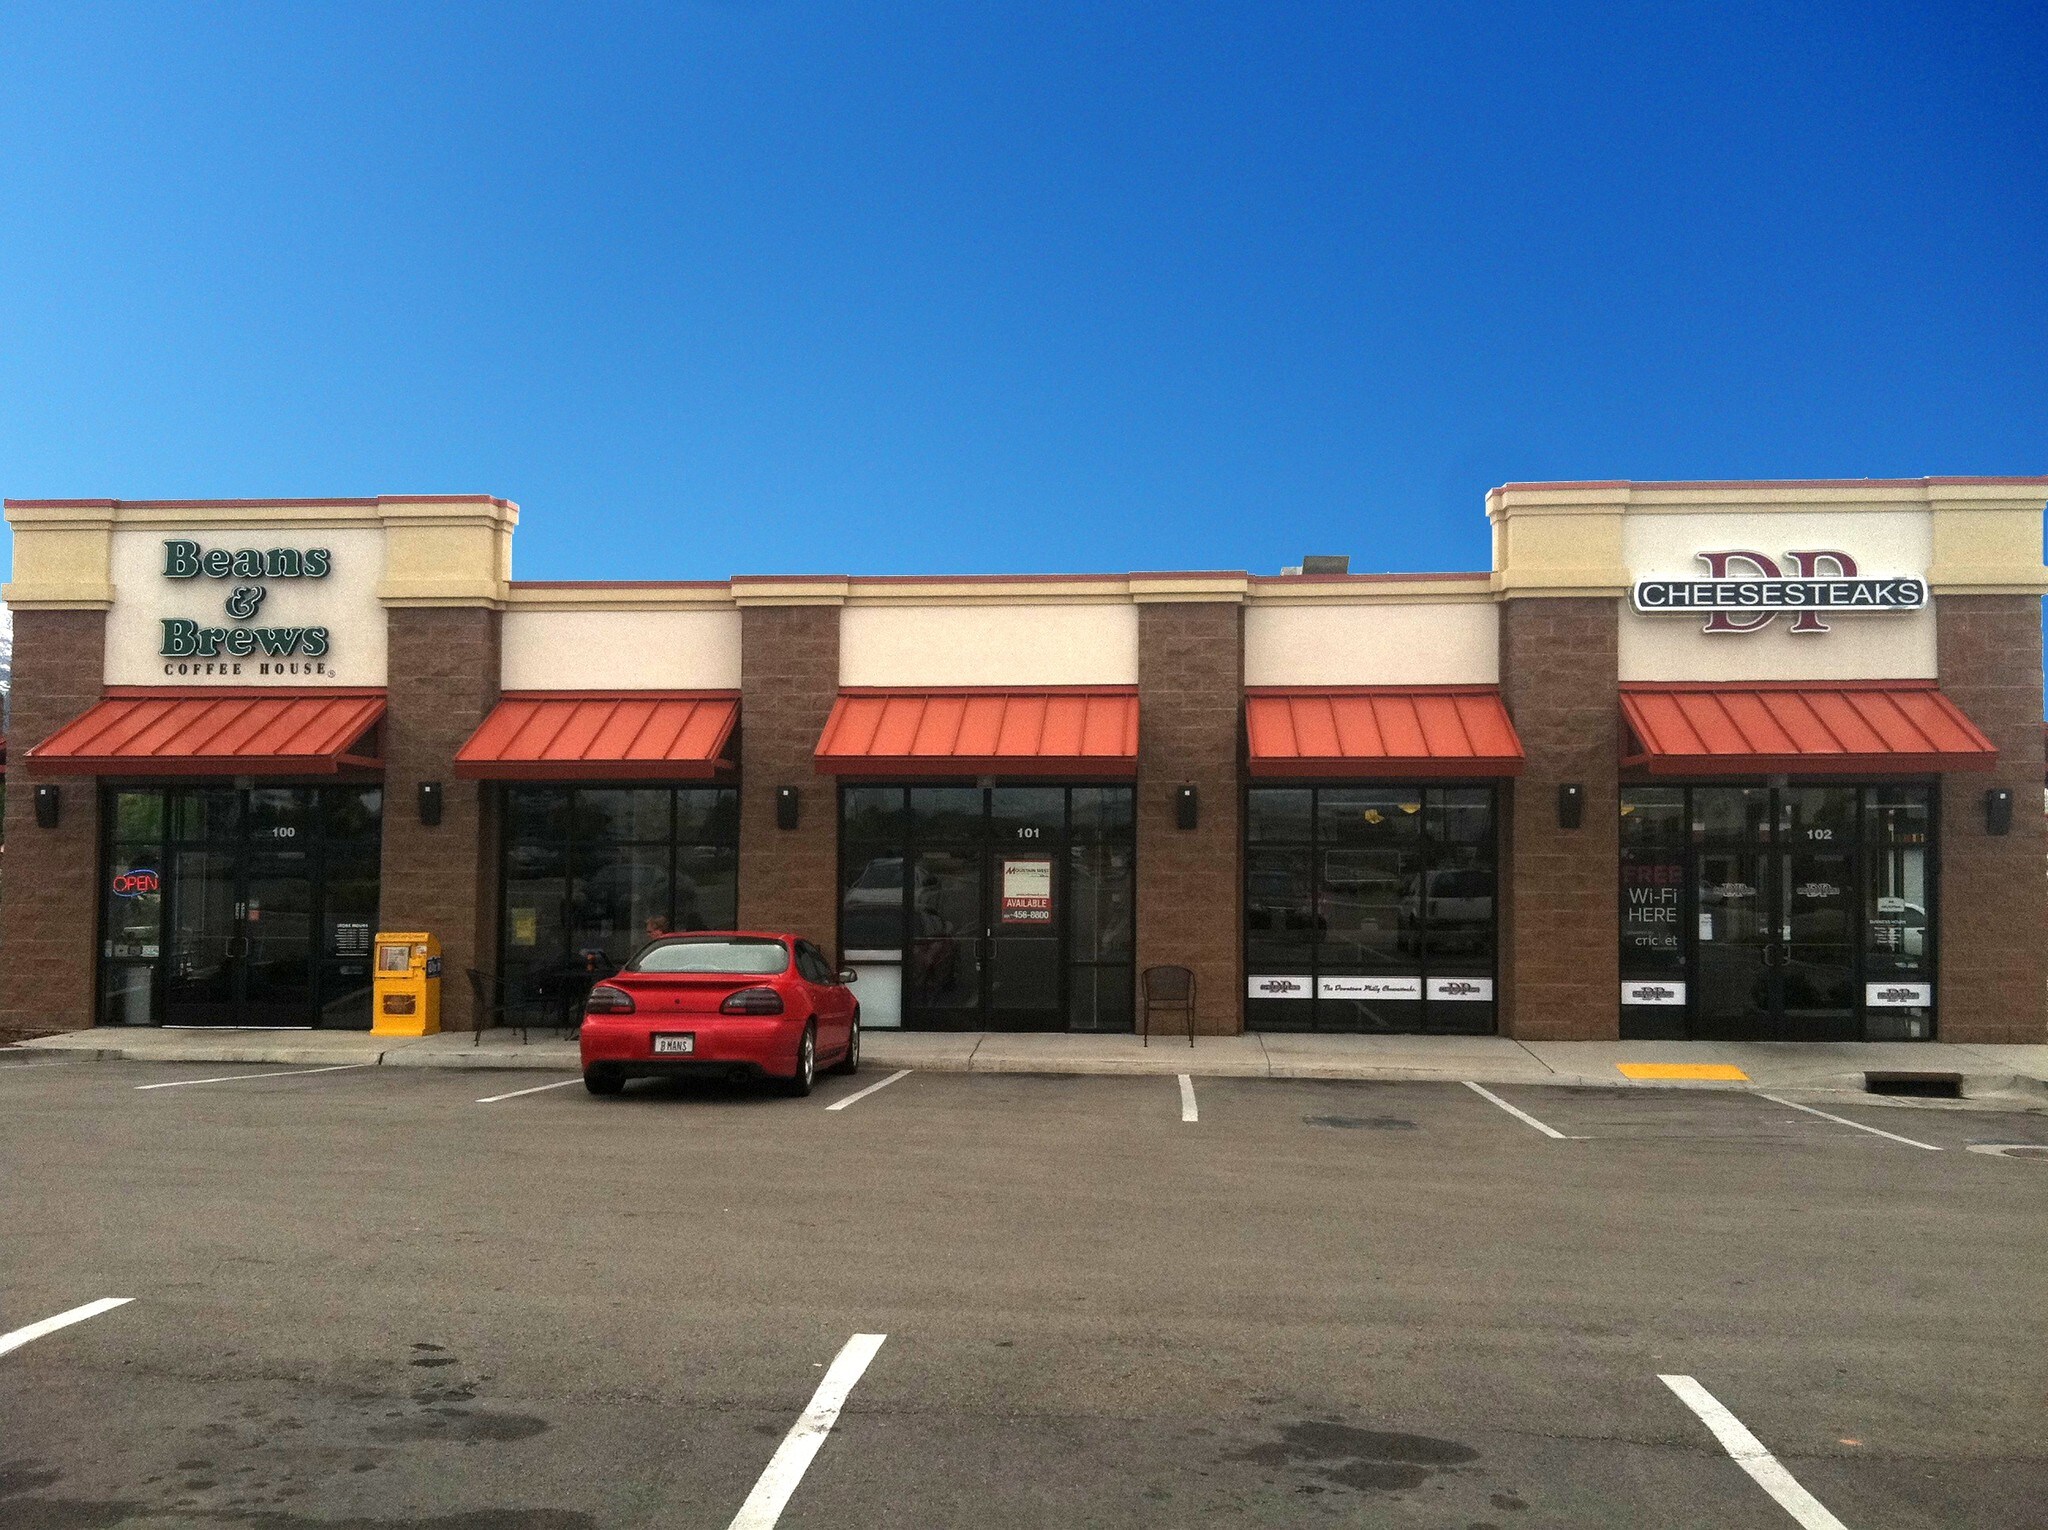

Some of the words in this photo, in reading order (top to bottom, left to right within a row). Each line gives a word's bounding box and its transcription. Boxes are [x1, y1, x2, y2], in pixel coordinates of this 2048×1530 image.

[161, 539, 331, 578] Beans
[225, 585, 266, 619] &
[1642, 582, 1919, 607] CHEESESTEAKS
[158, 618, 330, 658] Brews
[164, 663, 242, 676] COFFEE
[259, 662, 326, 676] HOUSE
[272, 827, 295, 838] 100
[1017, 827, 1040, 838] 101
[1807, 829, 1833, 840] 102
[113, 875, 159, 892] OPEN
[1007, 898, 1047, 908] AVAILABLE
[1628, 887, 1677, 904] Wi-Fi
[1629, 907, 1677, 922] HERE
